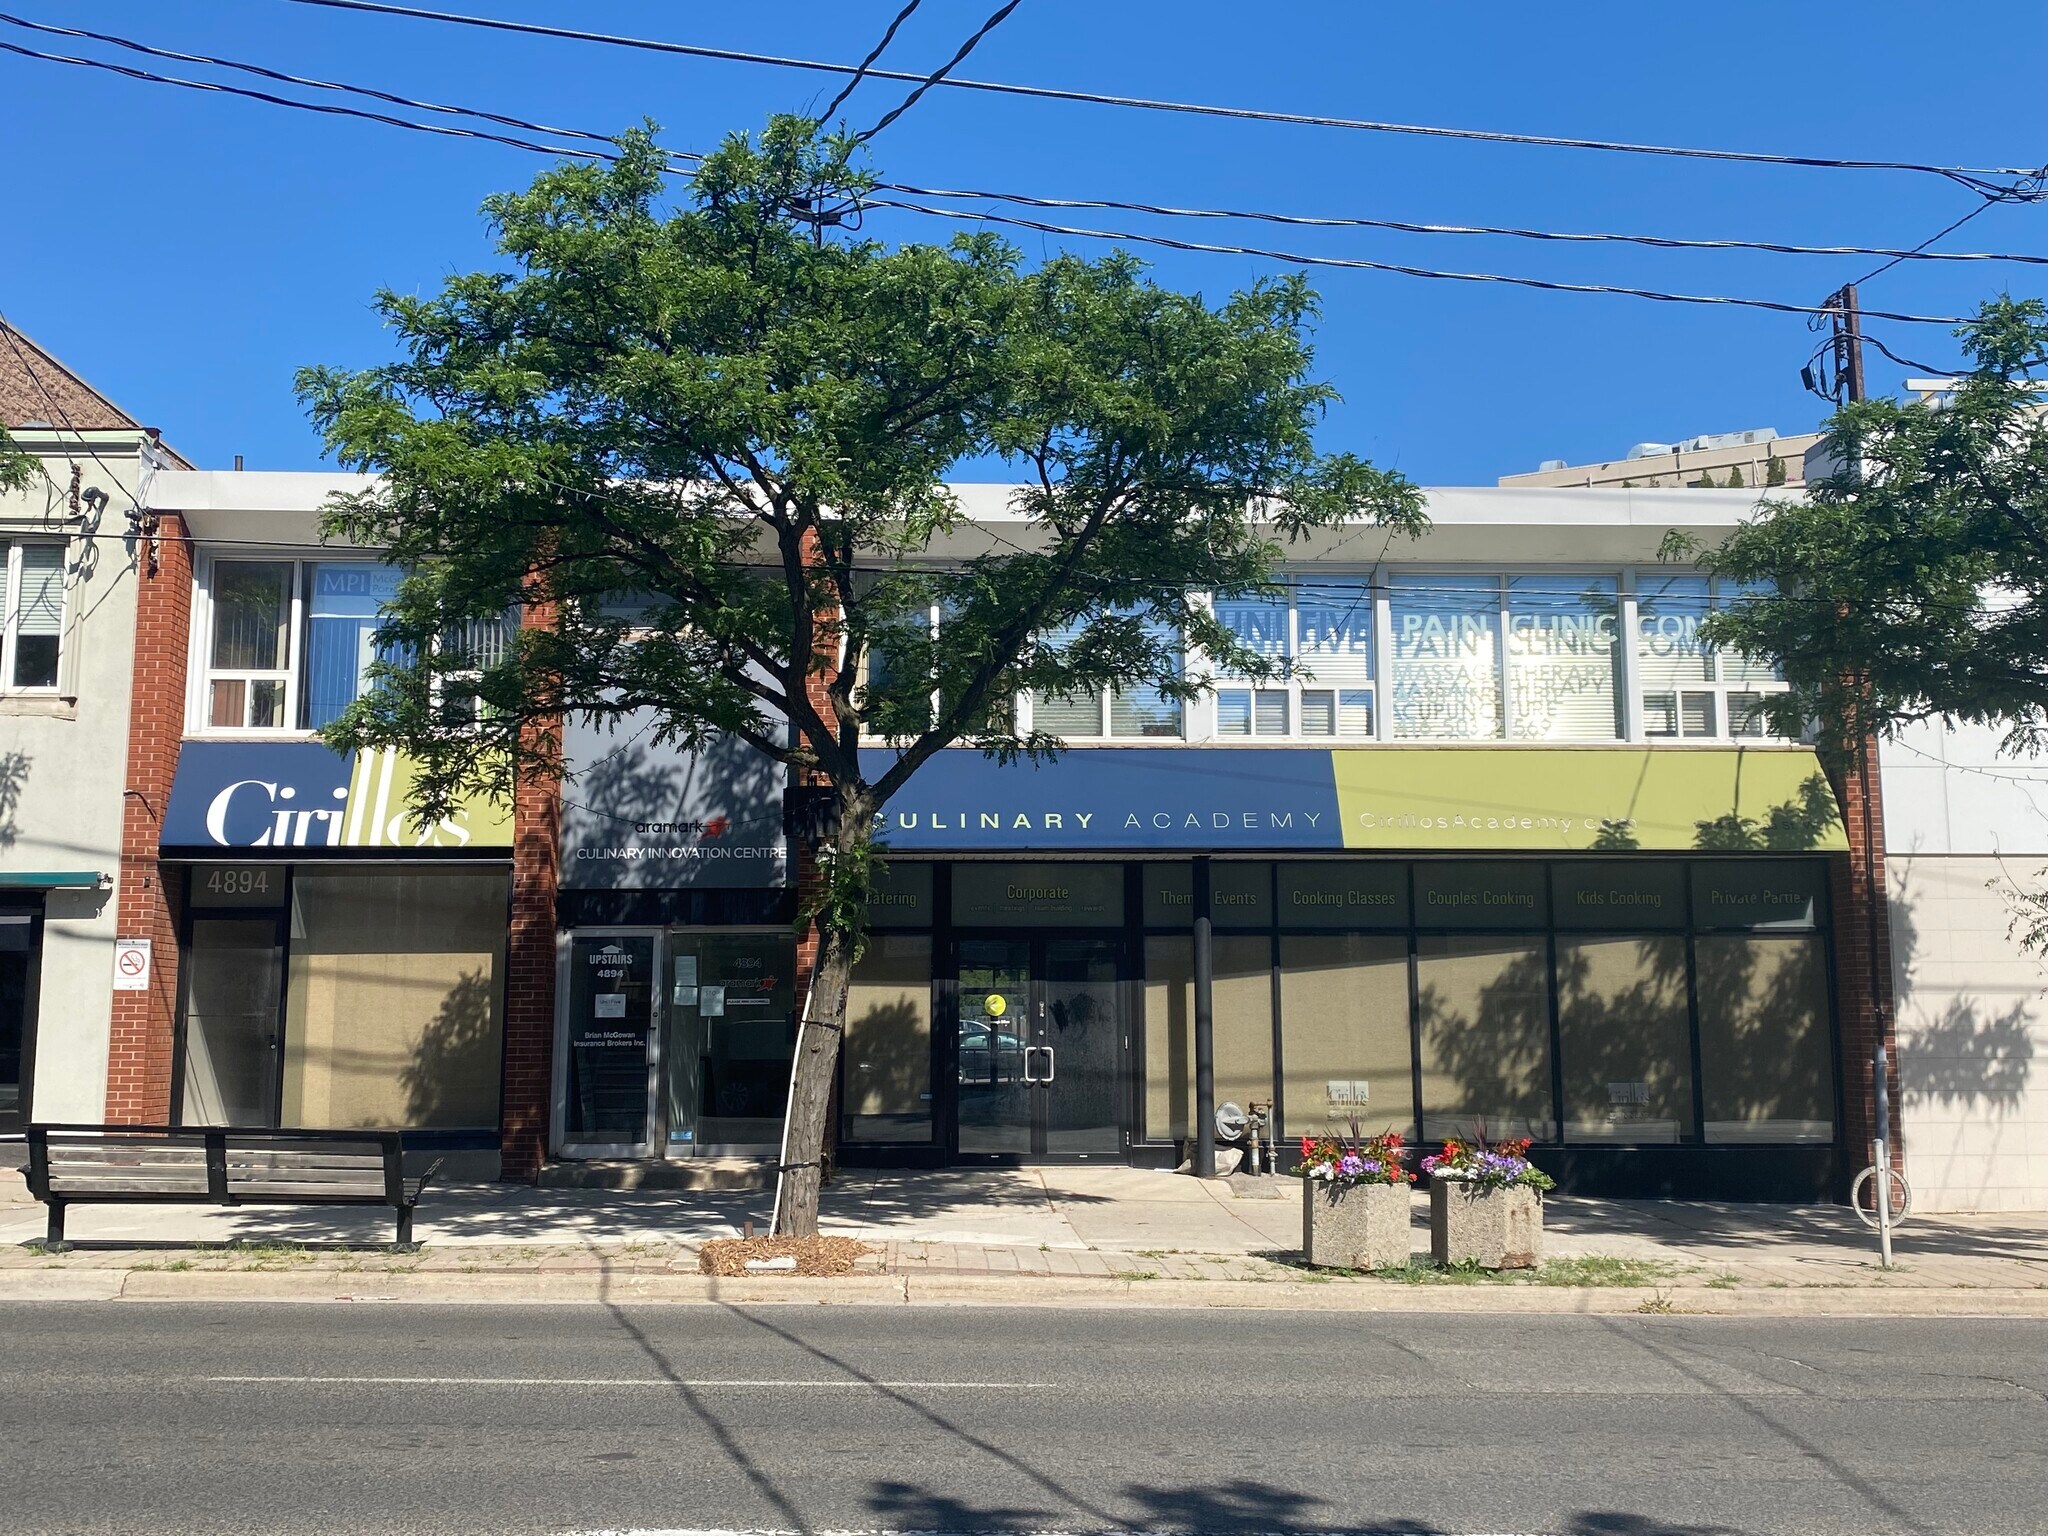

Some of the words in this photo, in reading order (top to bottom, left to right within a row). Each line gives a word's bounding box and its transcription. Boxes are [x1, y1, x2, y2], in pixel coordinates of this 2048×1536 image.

[323, 573, 365, 592] MPI
[1403, 614, 1488, 642] PAIN
[1510, 614, 1618, 643] CLINIC
[1511, 664, 1611, 681] THERAPY
[635, 819, 703, 834] aramark
[1124, 812, 1322, 829] ACADEMY
[576, 847, 645, 860] CULINARY
[648, 847, 731, 859] INNOVATION
[733, 847, 788, 858] CENTRE
[207, 870, 269, 894] 4894
[1007, 884, 1069, 902] Corporate
[1160, 890, 1194, 905] Them
[1214, 890, 1257, 905] Events
[1293, 890, 1343, 908] Cooking
[1347, 890, 1396, 905] Classes
[1427, 890, 1477, 908] Couples
[1483, 890, 1535, 908] Cooking
[1577, 890, 1605, 905] Kids
[1609, 890, 1662, 908] Cooking
[1711, 889, 1758, 904] Private
[589, 955, 633, 965] UPSTAIRS
[733, 957, 762, 969] 4894
[597, 969, 624, 978] 4894
